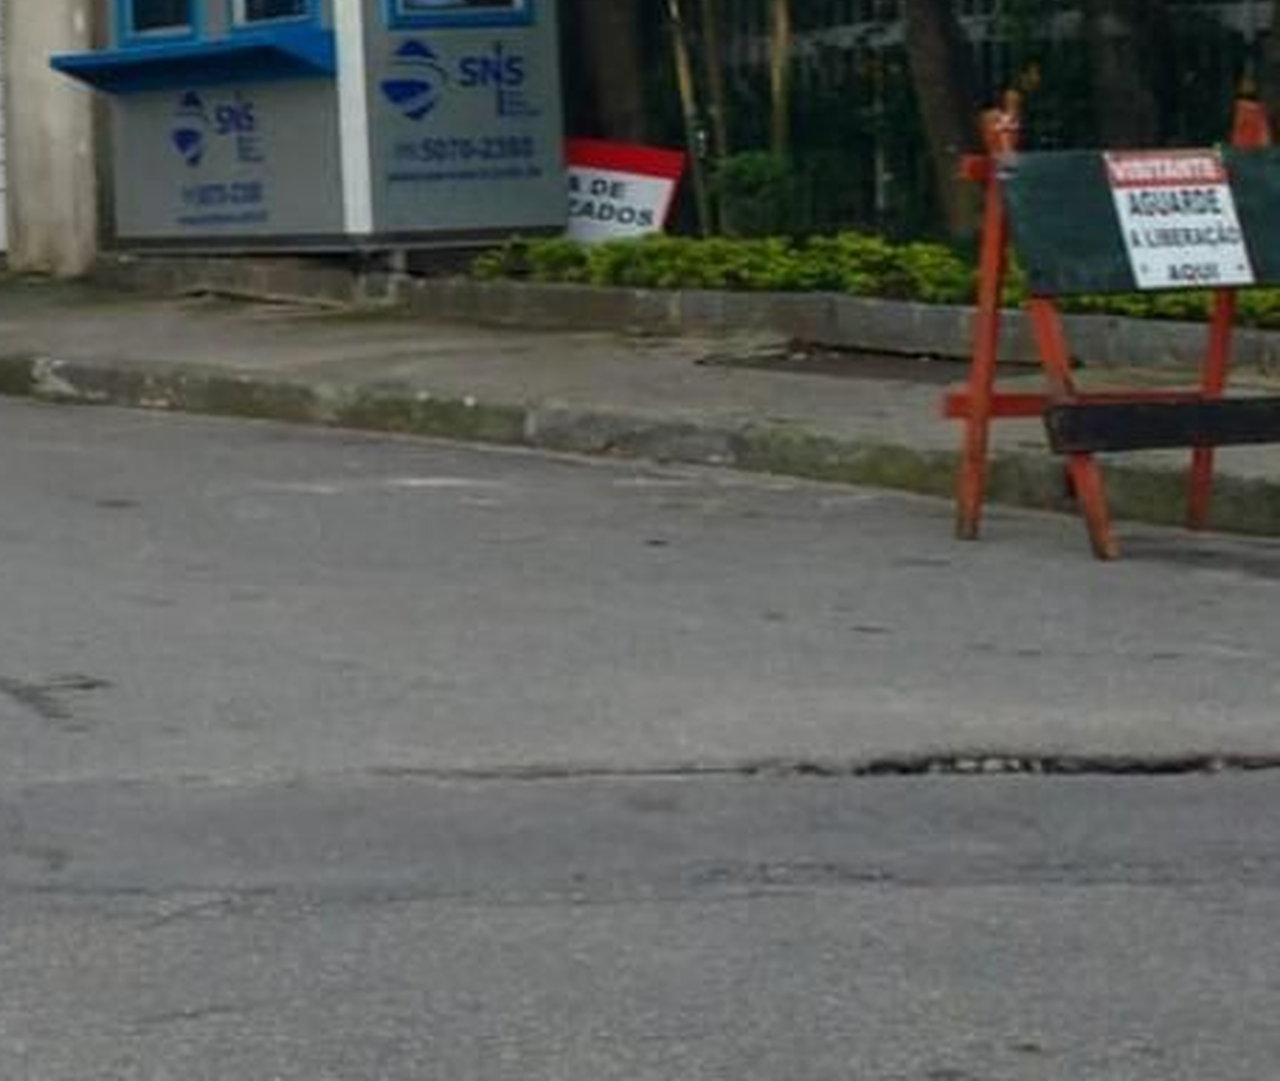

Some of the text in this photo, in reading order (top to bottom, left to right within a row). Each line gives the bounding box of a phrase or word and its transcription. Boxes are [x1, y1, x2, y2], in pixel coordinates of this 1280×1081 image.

[458, 54, 524, 87] SNS
[590, 178, 625, 199] DE
[1129, 188, 1223, 216] AGUARDE
[1168, 262, 1221, 282] AQUI
